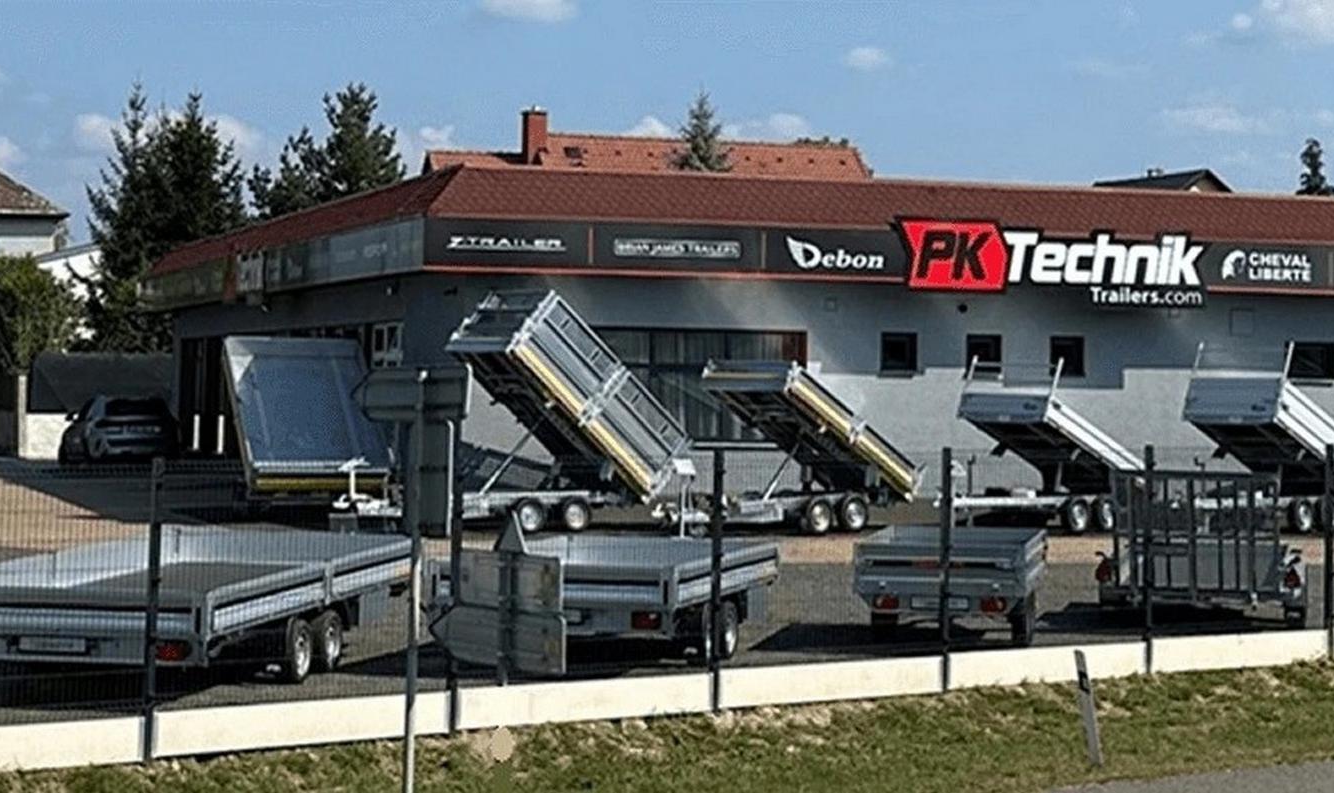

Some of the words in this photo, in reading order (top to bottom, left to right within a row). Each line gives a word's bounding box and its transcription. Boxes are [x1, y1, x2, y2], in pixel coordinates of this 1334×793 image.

[786, 236, 884, 269] Debon
[916, 230, 993, 280] PK
[1003, 232, 1203, 285] Technik
[1249, 253, 1310, 267] CHEVAL
[1090, 287, 1202, 305] Trailers.com
